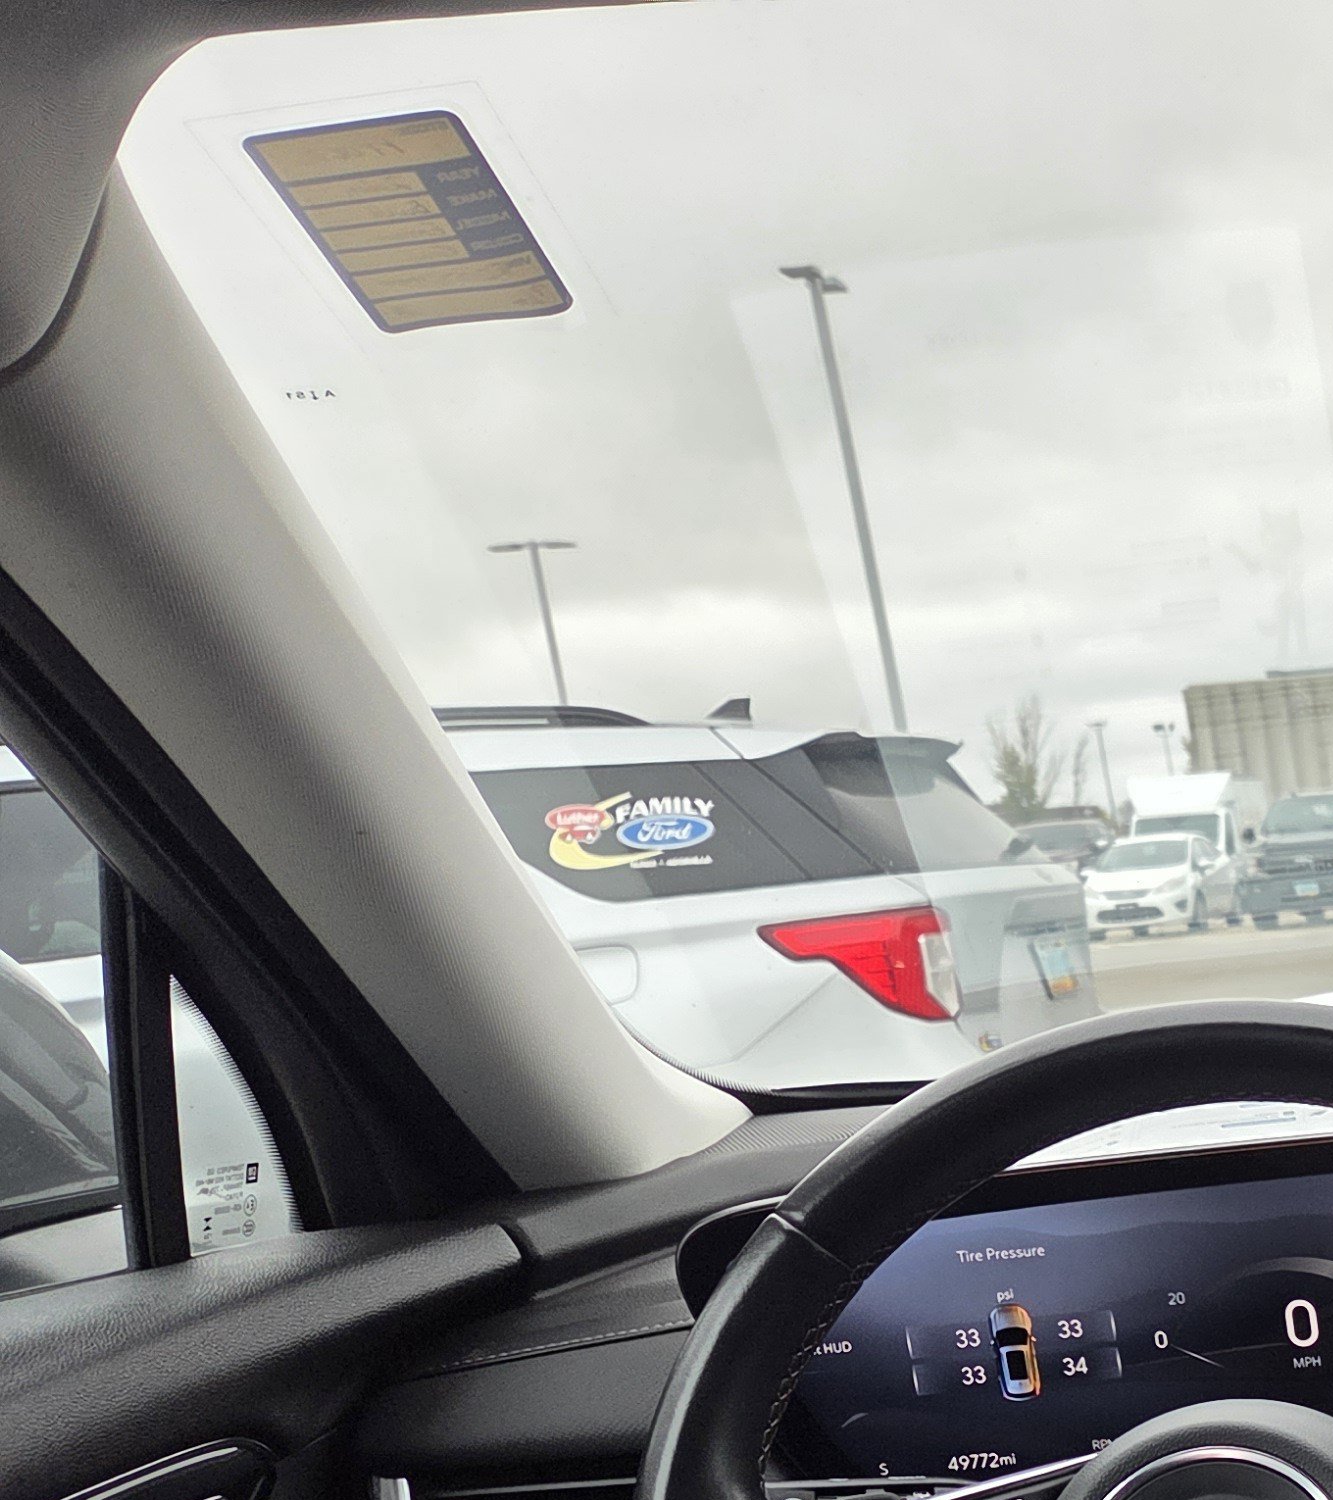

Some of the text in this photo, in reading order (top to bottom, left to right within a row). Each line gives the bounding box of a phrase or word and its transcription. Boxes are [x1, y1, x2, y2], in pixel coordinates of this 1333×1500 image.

[615, 796, 715, 824] FAMILY
[637, 820, 693, 843] Ford
[956, 1245, 1046, 1263] Tire Pressure
[996, 1288, 1014, 1303] psi
[1167, 1291, 1186, 1306] 20
[1057, 1319, 1084, 1340] 33
[1284, 1299, 1319, 1348] 0
[823, 1340, 853, 1355] HUD
[956, 1328, 981, 1348] 33
[1154, 1330, 1168, 1349] 0
[1062, 1356, 1089, 1377] 34
[1292, 1355, 1322, 1369] MPH
[961, 1365, 987, 1386] 33
[878, 1463, 889, 1476] S
[947, 1452, 1017, 1472] 49772mi
